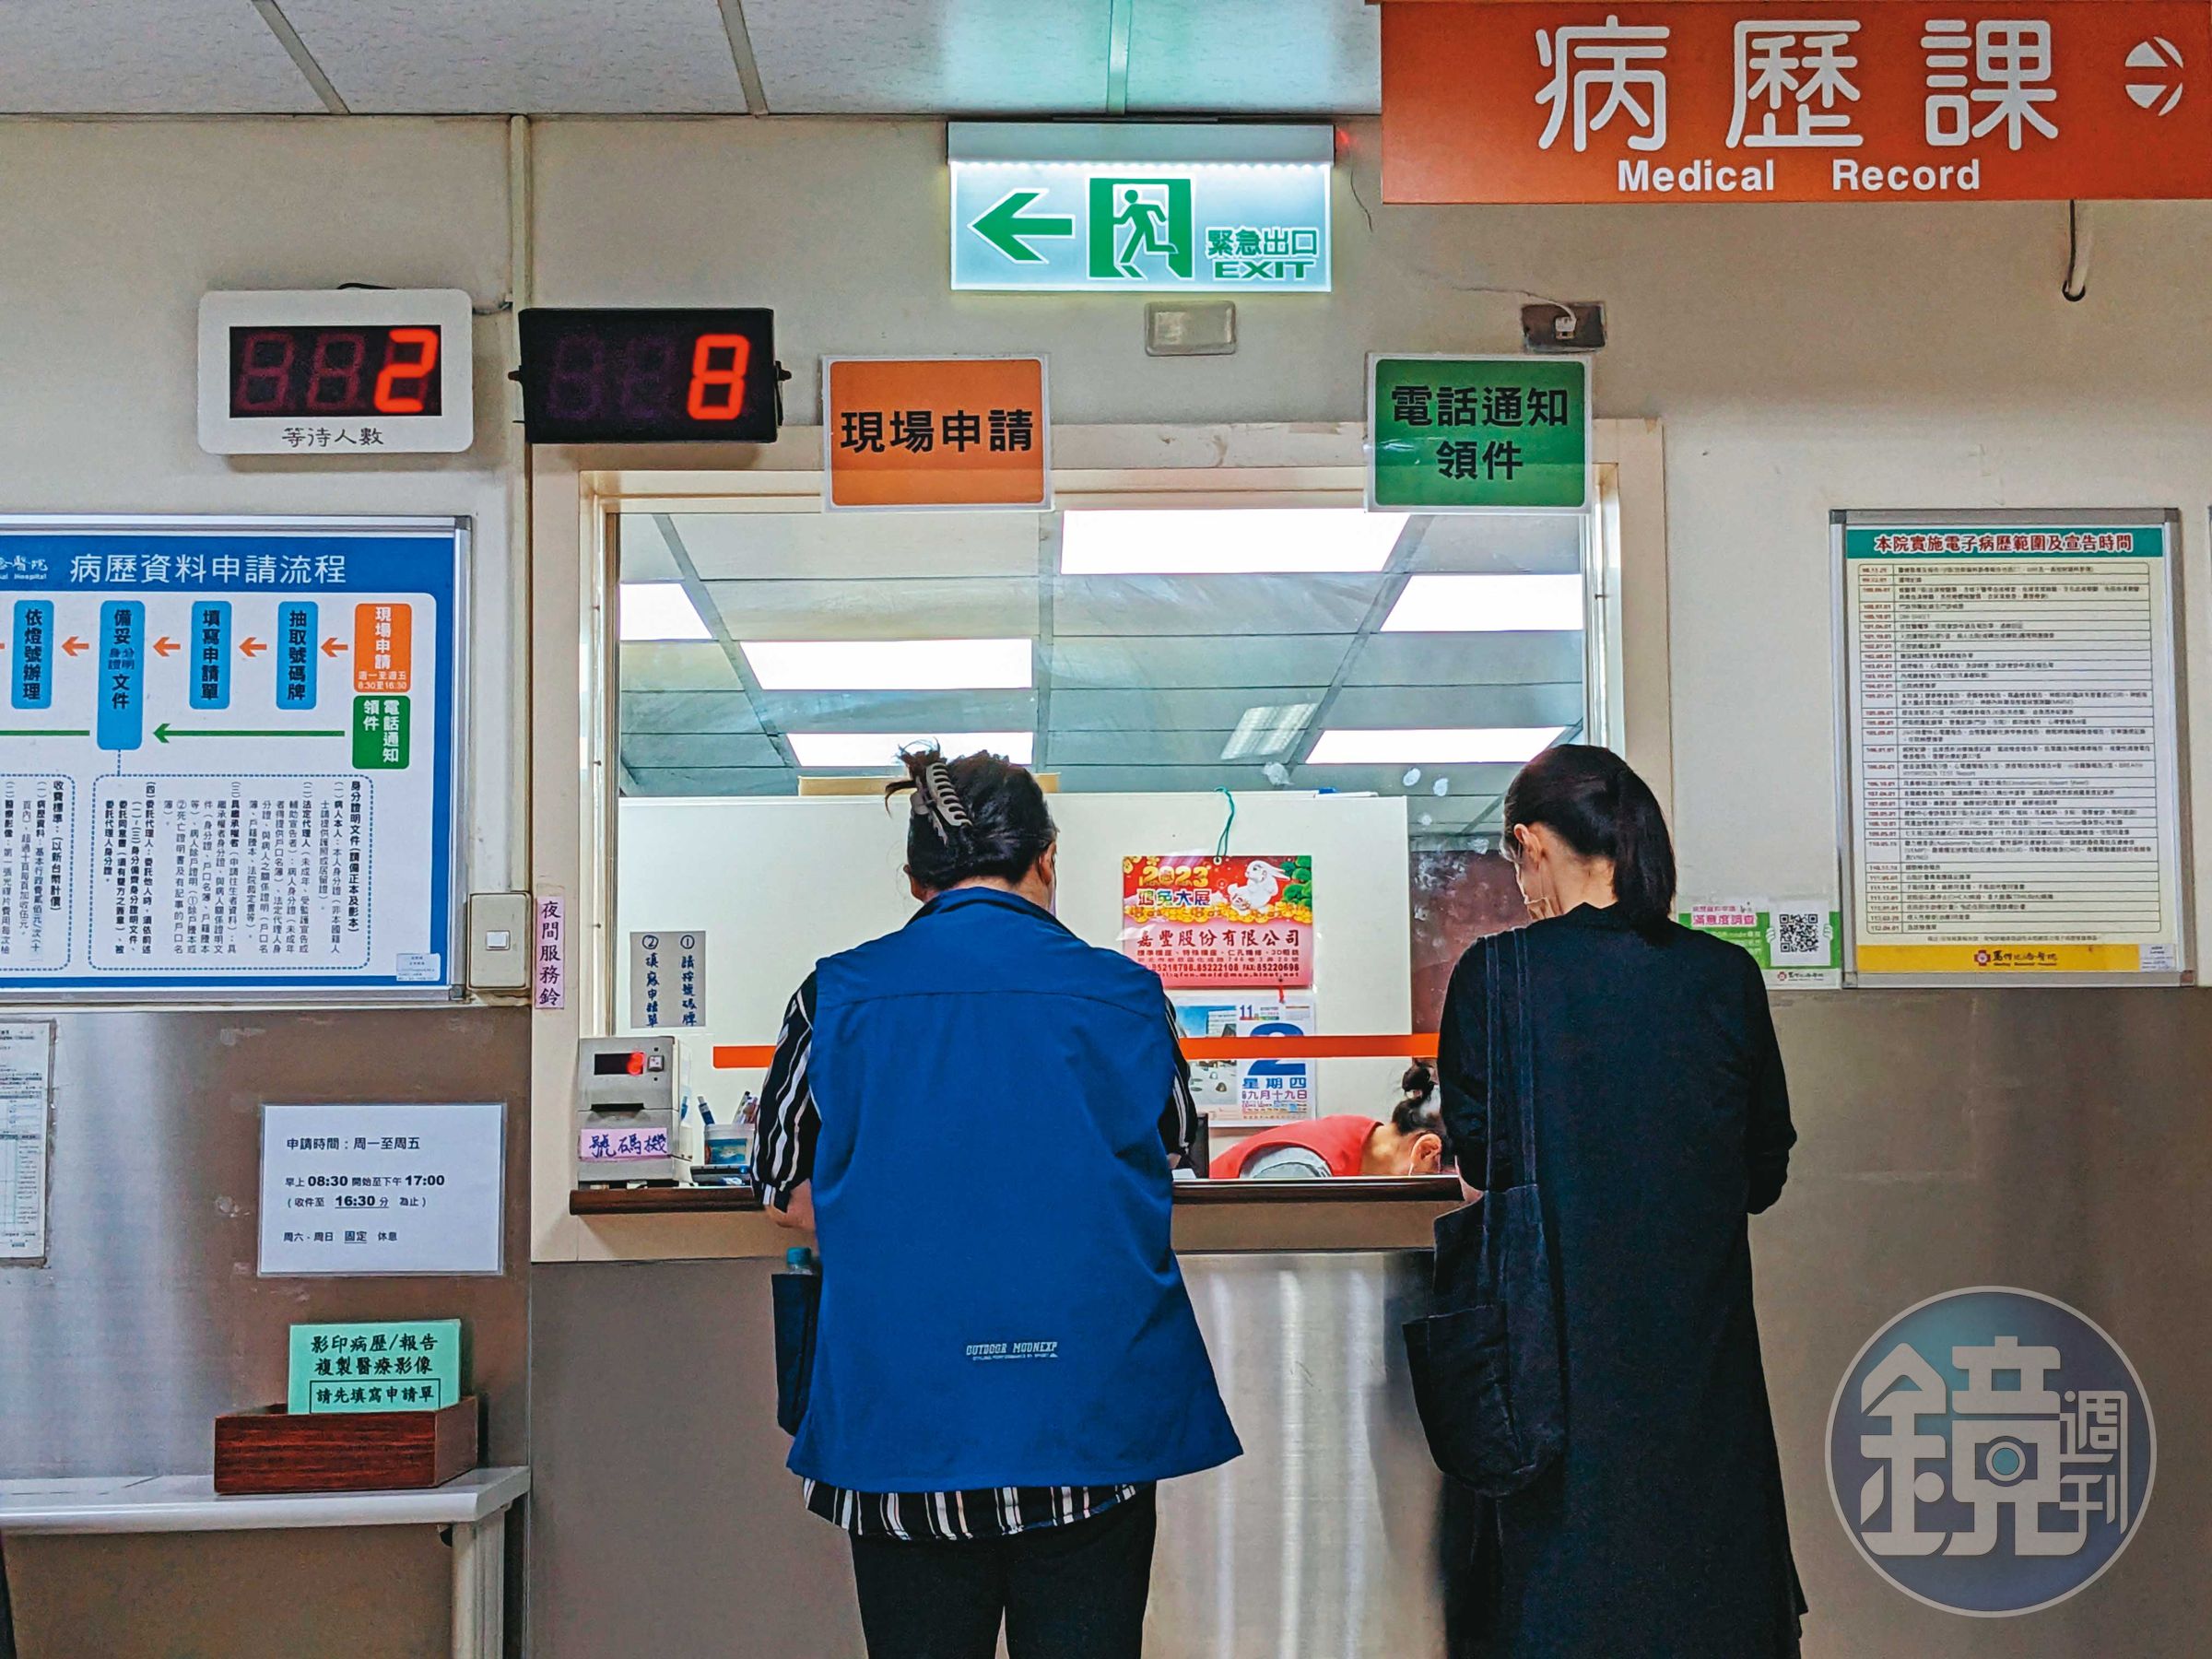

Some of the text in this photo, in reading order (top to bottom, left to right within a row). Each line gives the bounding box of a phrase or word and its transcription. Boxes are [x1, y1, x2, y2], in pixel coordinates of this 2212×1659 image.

[1535, 15, 2059, 153] 病歷課
[1618, 159, 1982, 193] Medical Record
[1207, 228, 1318, 256] 緊急出口
[1214, 260, 1315, 279] EXIT
[373, 328, 439, 413] 2
[687, 333, 751, 420] 8
[1392, 385, 1568, 428] 電話通知
[281, 426, 384, 447] 等待人數
[841, 409, 1033, 453] 現場申請
[1436, 441, 1524, 480] 領件
[70, 554, 347, 584] 病歷資料申請流程
[375, 606, 391, 669] 現場申請
[23, 608, 42, 700] 依燈號辦理
[201, 609, 220, 700] 填寫申請單
[288, 610, 307, 700] 抽取號碼牌
[363, 700, 380, 731] 領件
[382, 700, 399, 762] 電話通知
[1142, 866, 1208, 887] 2023
[539, 900, 560, 1006] 夜間服務鈴
[1242, 1077, 1307, 1088] 星期四
[589, 1134, 667, 1158] 號碼機
[308, 1176, 347, 1186] 08:30
[405, 1175, 444, 1186] 17:00
[335, 1195, 375, 1206] 16:30
[311, 1333, 438, 1352] 影印病歷/報告
[314, 1356, 433, 1376] 複製醫療影像
[317, 1386, 434, 1404] 請先填寫申請單
